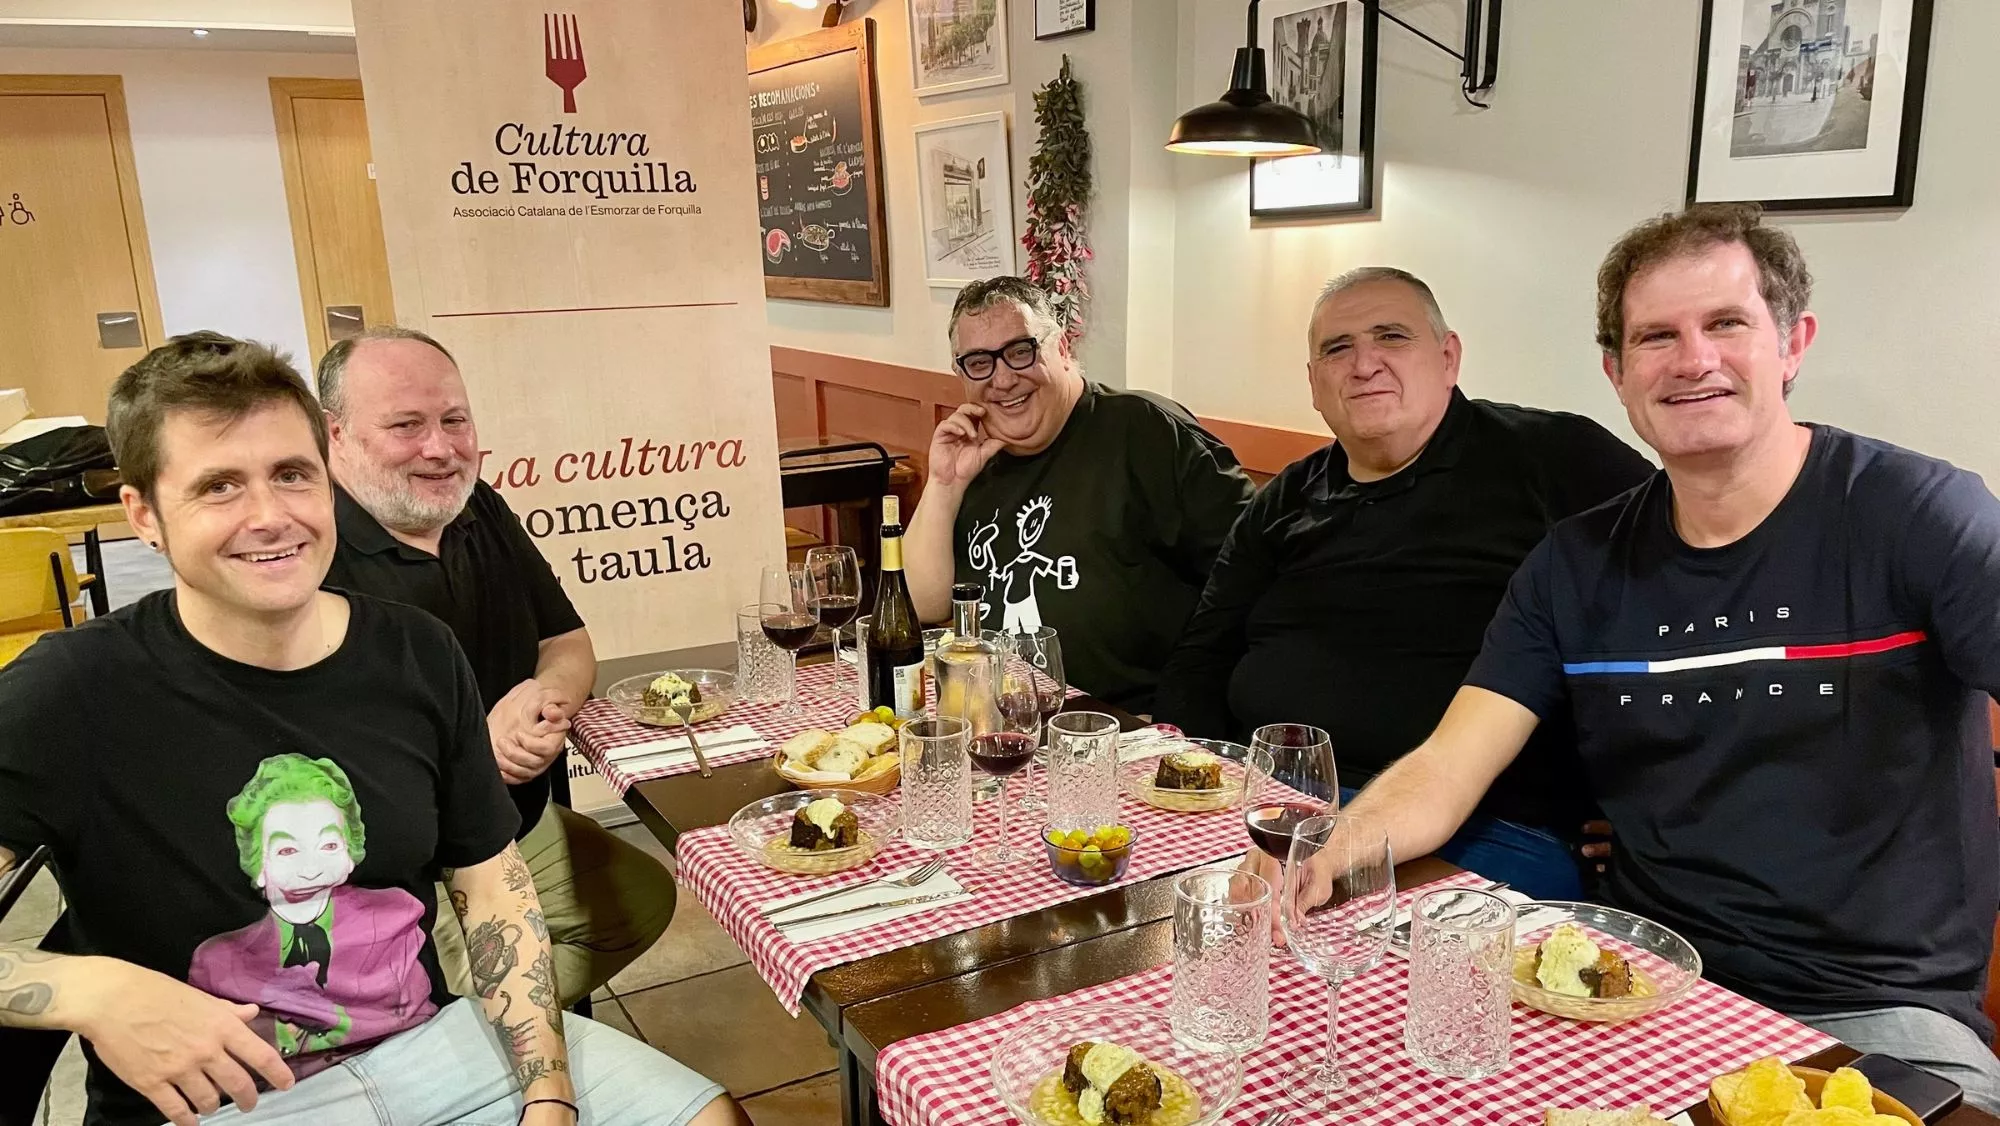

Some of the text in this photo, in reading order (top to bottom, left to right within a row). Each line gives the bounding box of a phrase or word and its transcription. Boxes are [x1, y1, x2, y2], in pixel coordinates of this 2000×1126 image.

[495, 122, 650, 156] Cultura
[450, 162, 697, 199] de Forquilla
[453, 204, 702, 218] Associació Catalana de l'Esmorzar de Forquilla
[554, 437, 747, 484] cultura
[515, 489, 731, 539] omença
[571, 536, 712, 585] taula
[1658, 606, 1790, 637] PARIS
[1620, 683, 1834, 706] FRANCE
